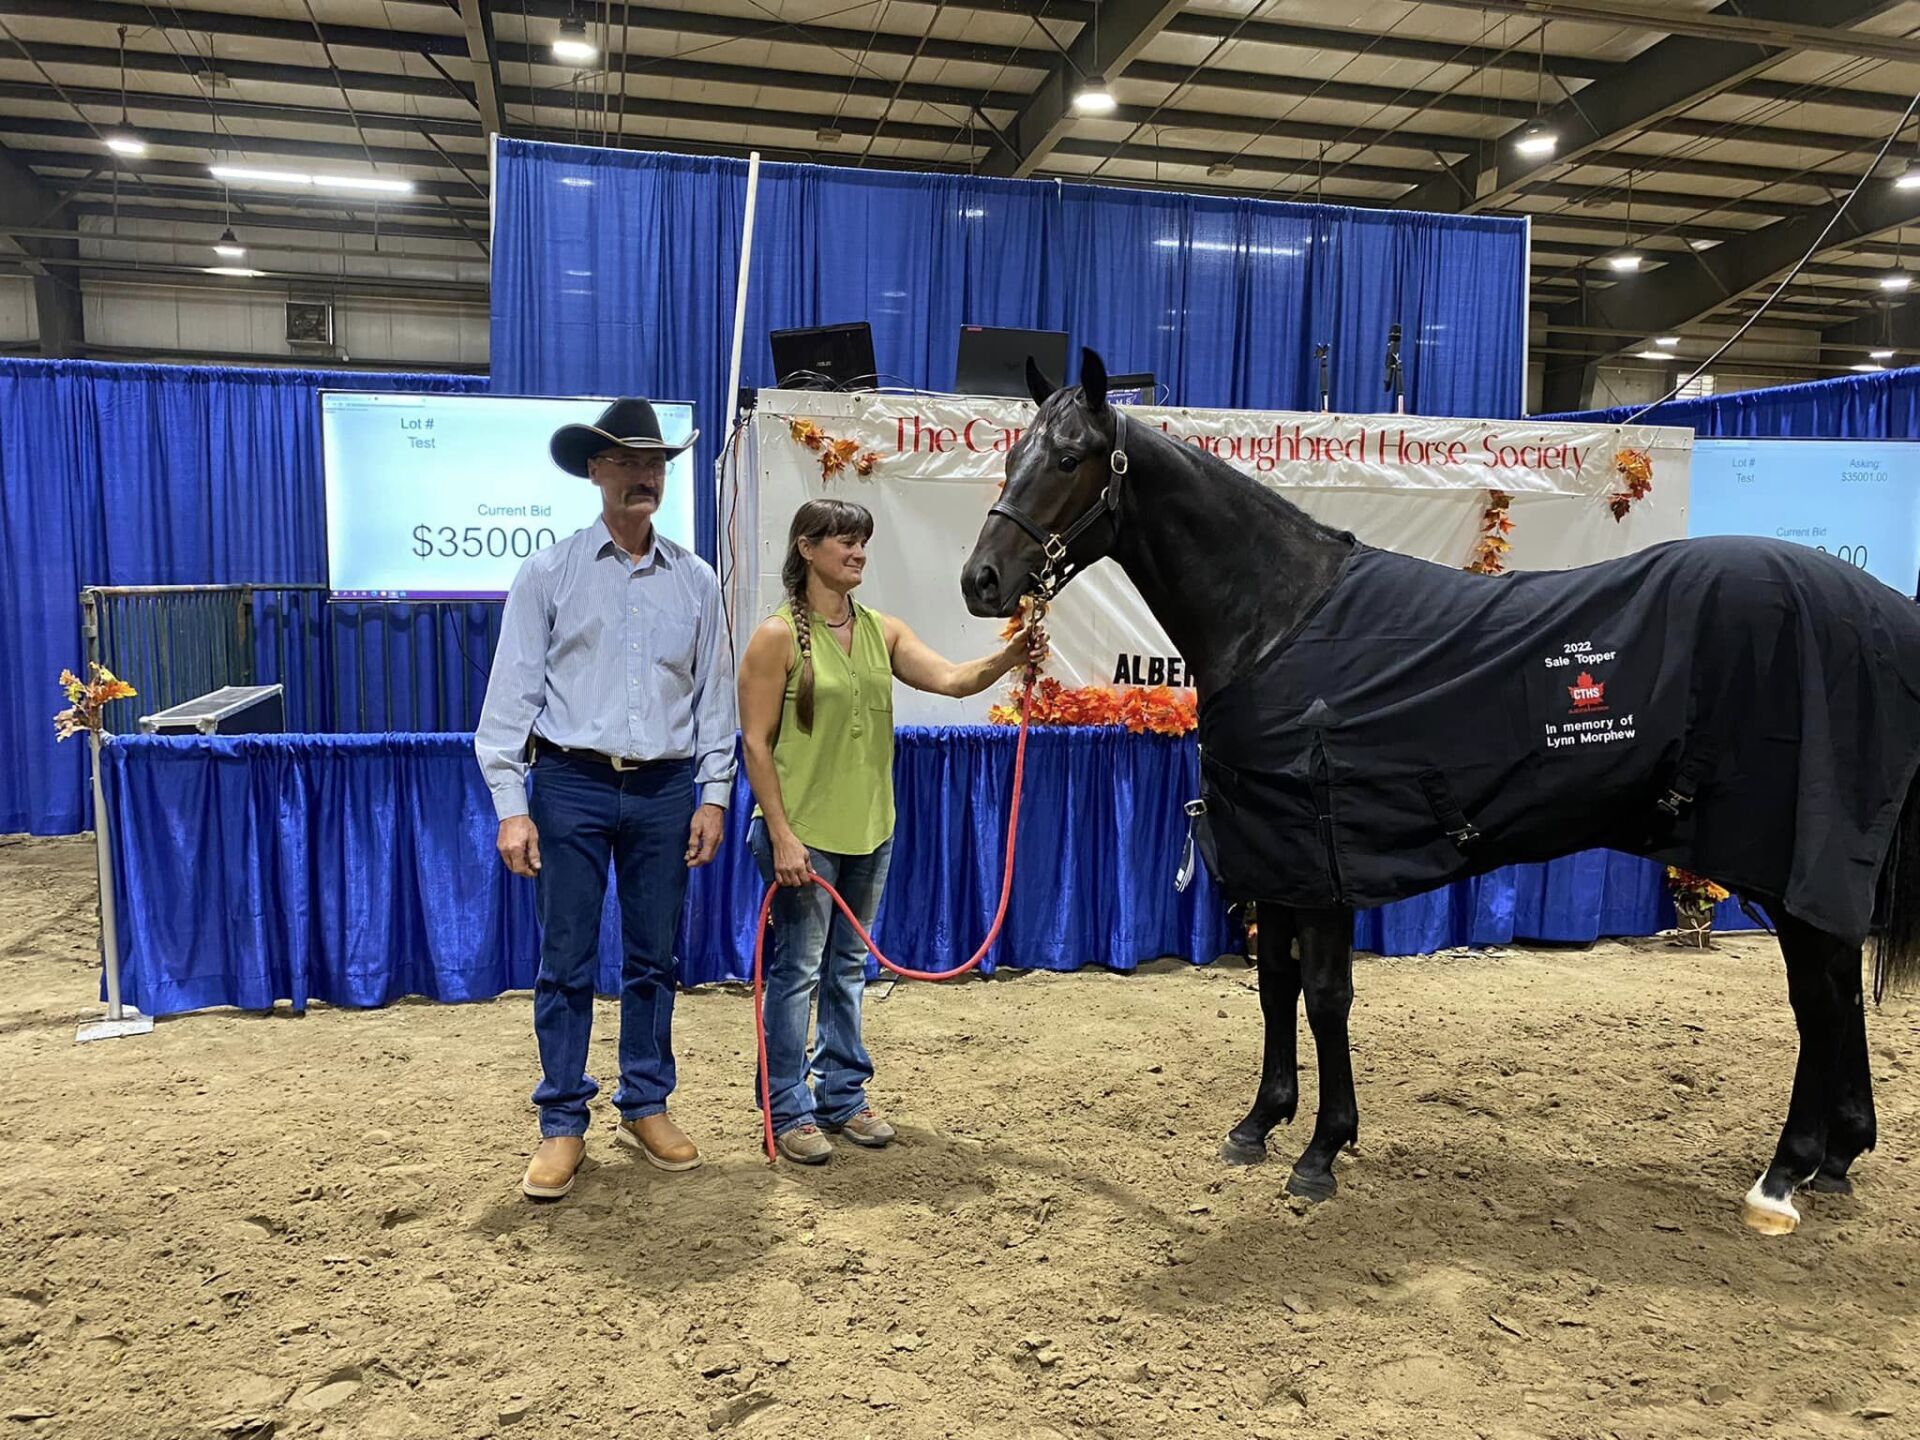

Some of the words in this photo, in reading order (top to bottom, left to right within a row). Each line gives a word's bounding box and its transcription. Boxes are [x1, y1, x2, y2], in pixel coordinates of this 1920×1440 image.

[400, 417, 423, 430] Lot
[407, 436, 436, 450] Test
[888, 416, 957, 453] The
[1151, 421, 1366, 472] oroughbred
[1379, 429, 1467, 466] Horse
[1482, 434, 1591, 481] Society
[1732, 457, 1747, 468] Lot
[1736, 473, 1755, 483] Test
[1841, 471, 1888, 482] $35001.00
[477, 503, 527, 517] Current
[530, 504, 552, 517] Bid
[1776, 527, 1810, 537] Current
[1812, 527, 1827, 537] Bid
[411, 523, 583, 561] $35000
[1563, 641, 1593, 653] 2022
[1544, 656, 1570, 668] Sale
[1575, 651, 1617, 665] Topper
[1573, 687, 1600, 700] CTHS
[1545, 723, 1557, 734] In
[1563, 718, 1614, 732] memory
[1620, 714, 1634, 726] of
[1546, 736, 1575, 749] Lynn
[1580, 728, 1636, 744] Morphew
